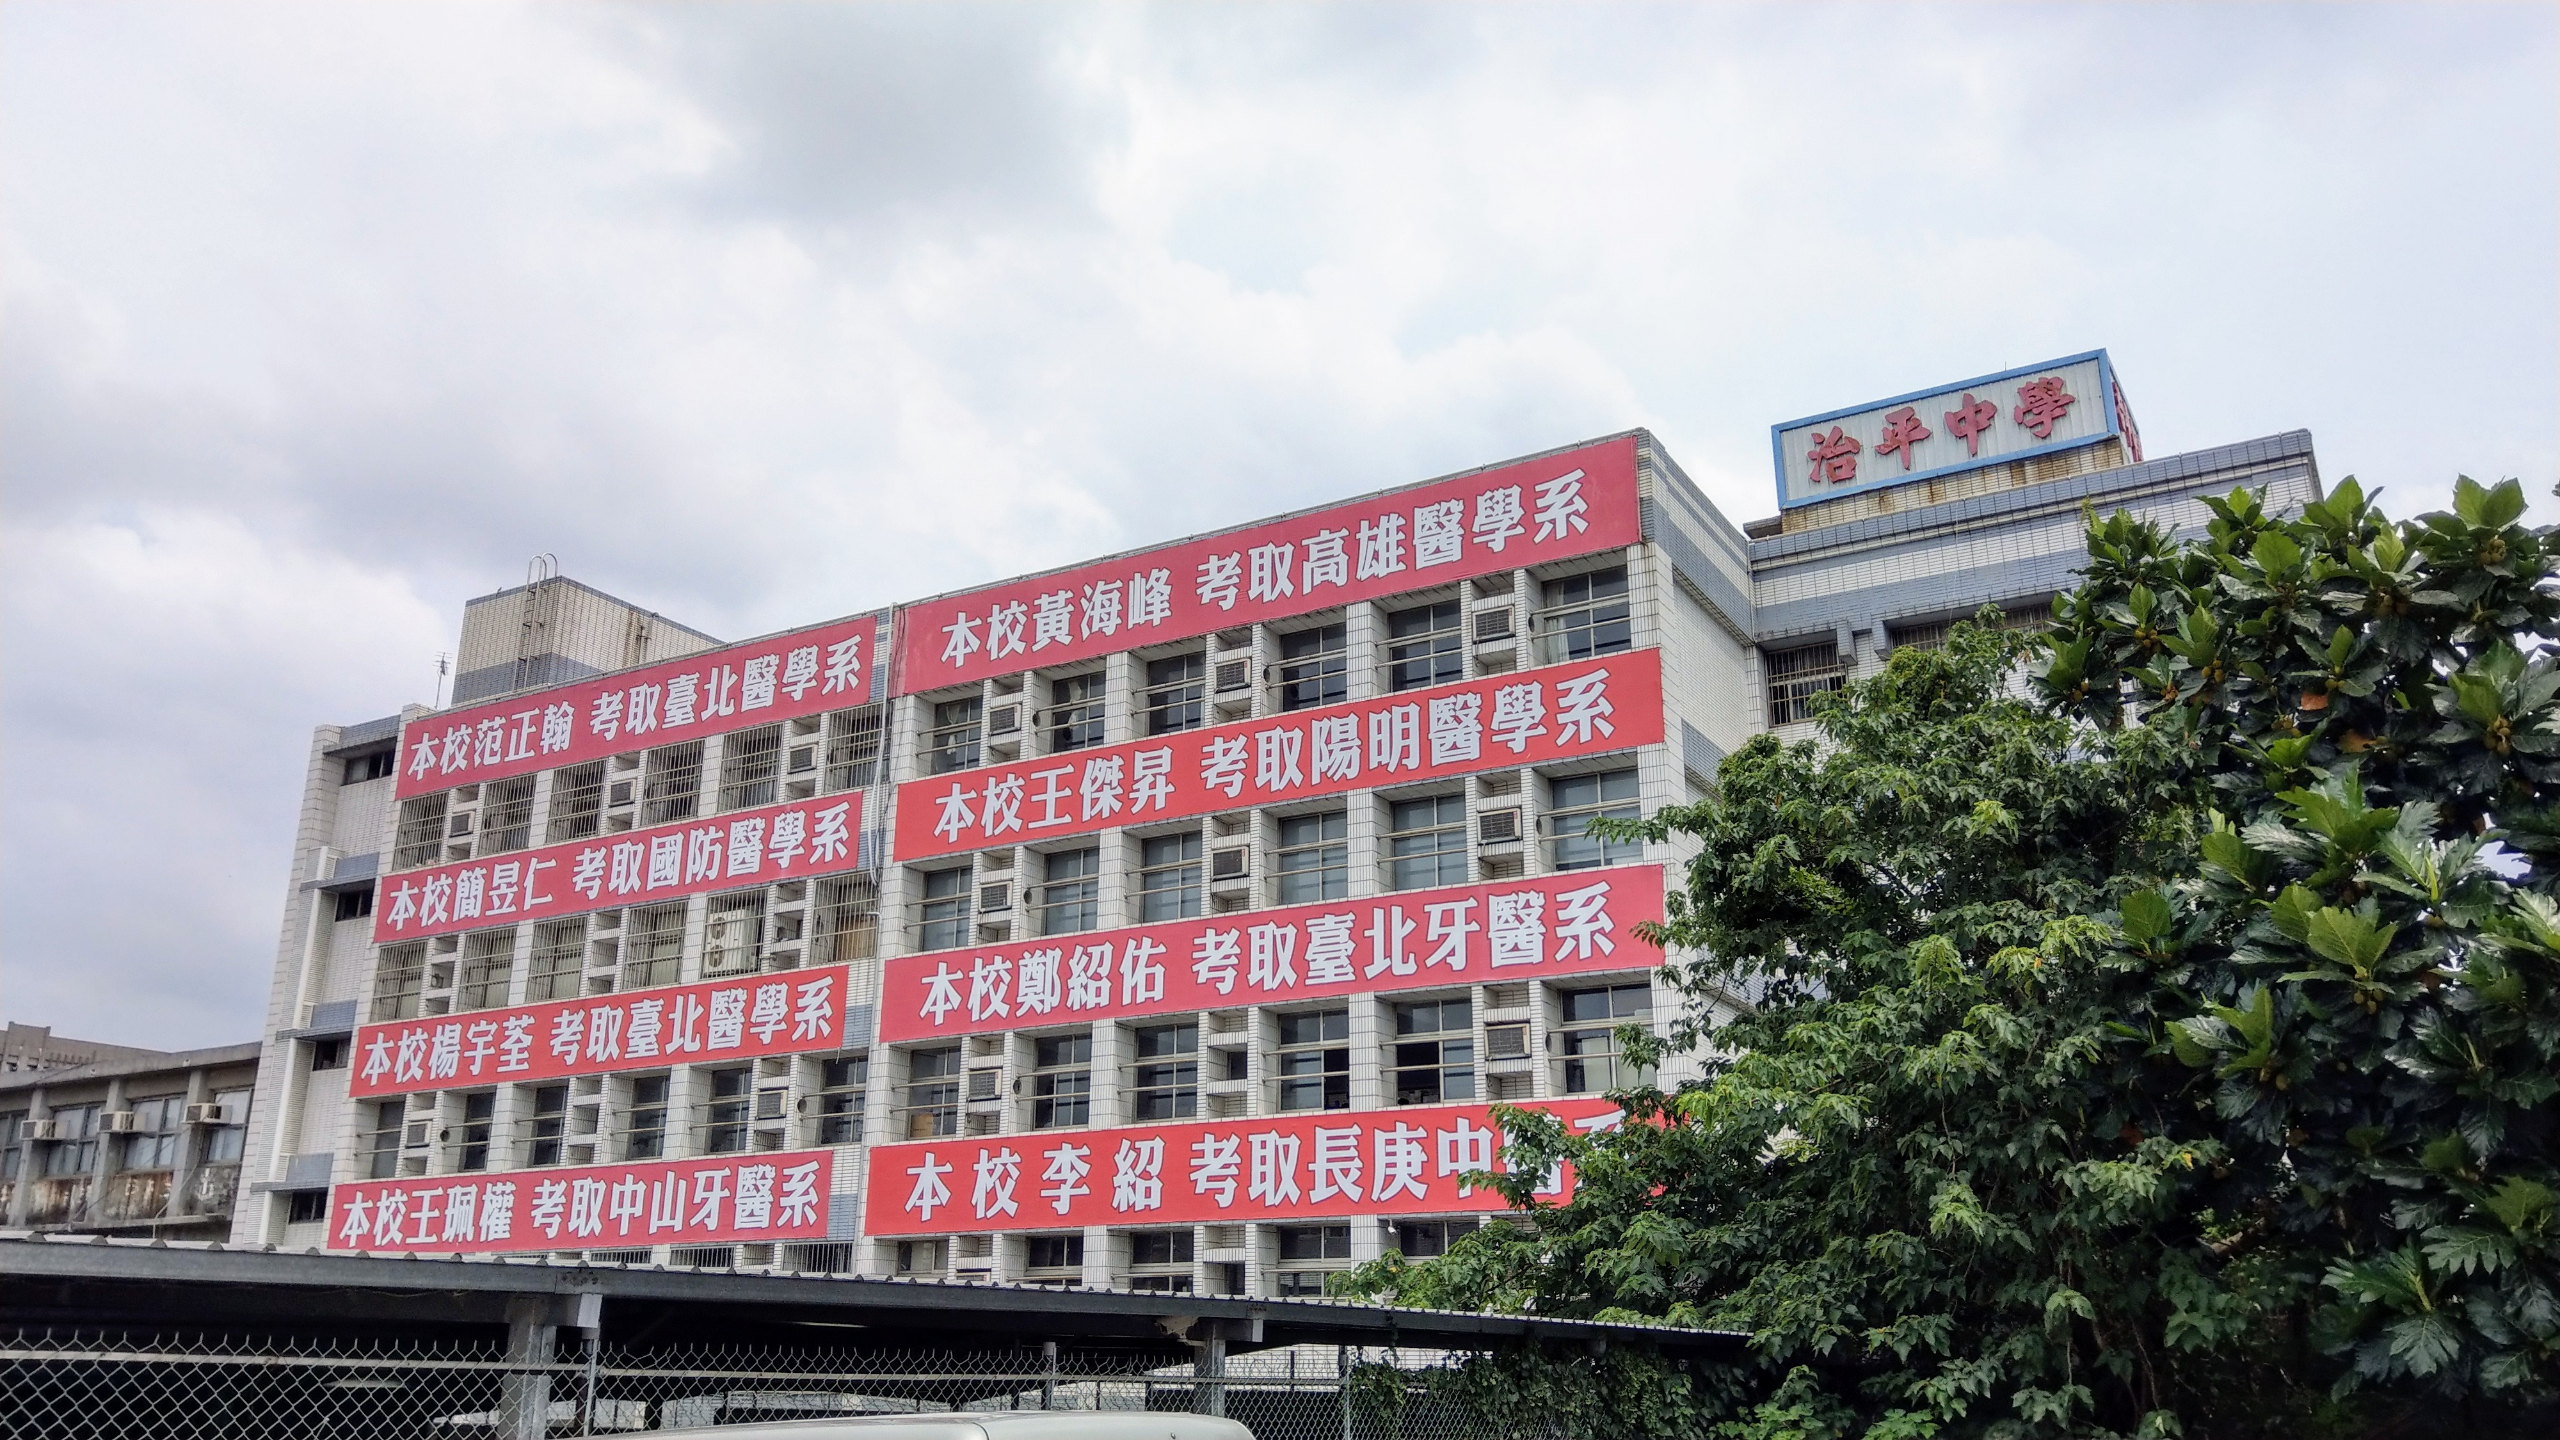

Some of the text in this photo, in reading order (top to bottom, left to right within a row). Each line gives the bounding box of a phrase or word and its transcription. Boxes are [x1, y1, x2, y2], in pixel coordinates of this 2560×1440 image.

[1806, 375, 2076, 484] 治平中學
[939, 467, 1590, 668] 本校黃海峰 考取高雄醫學系
[406, 633, 862, 782] 本校范正翰 考取臺北醫學系
[933, 667, 1616, 843] 本校王傑昇 考取陽明醫學系
[385, 800, 850, 931] 本校簡昱仁 考取國防醫學系
[918, 880, 1616, 1027] 本校鄭紹佑 考取臺北牙醫系
[359, 974, 835, 1086] 本校楊宇荃 考取臺北醫學系
[338, 1159, 821, 1248] 本校王珮權 考取中山牙醫系
